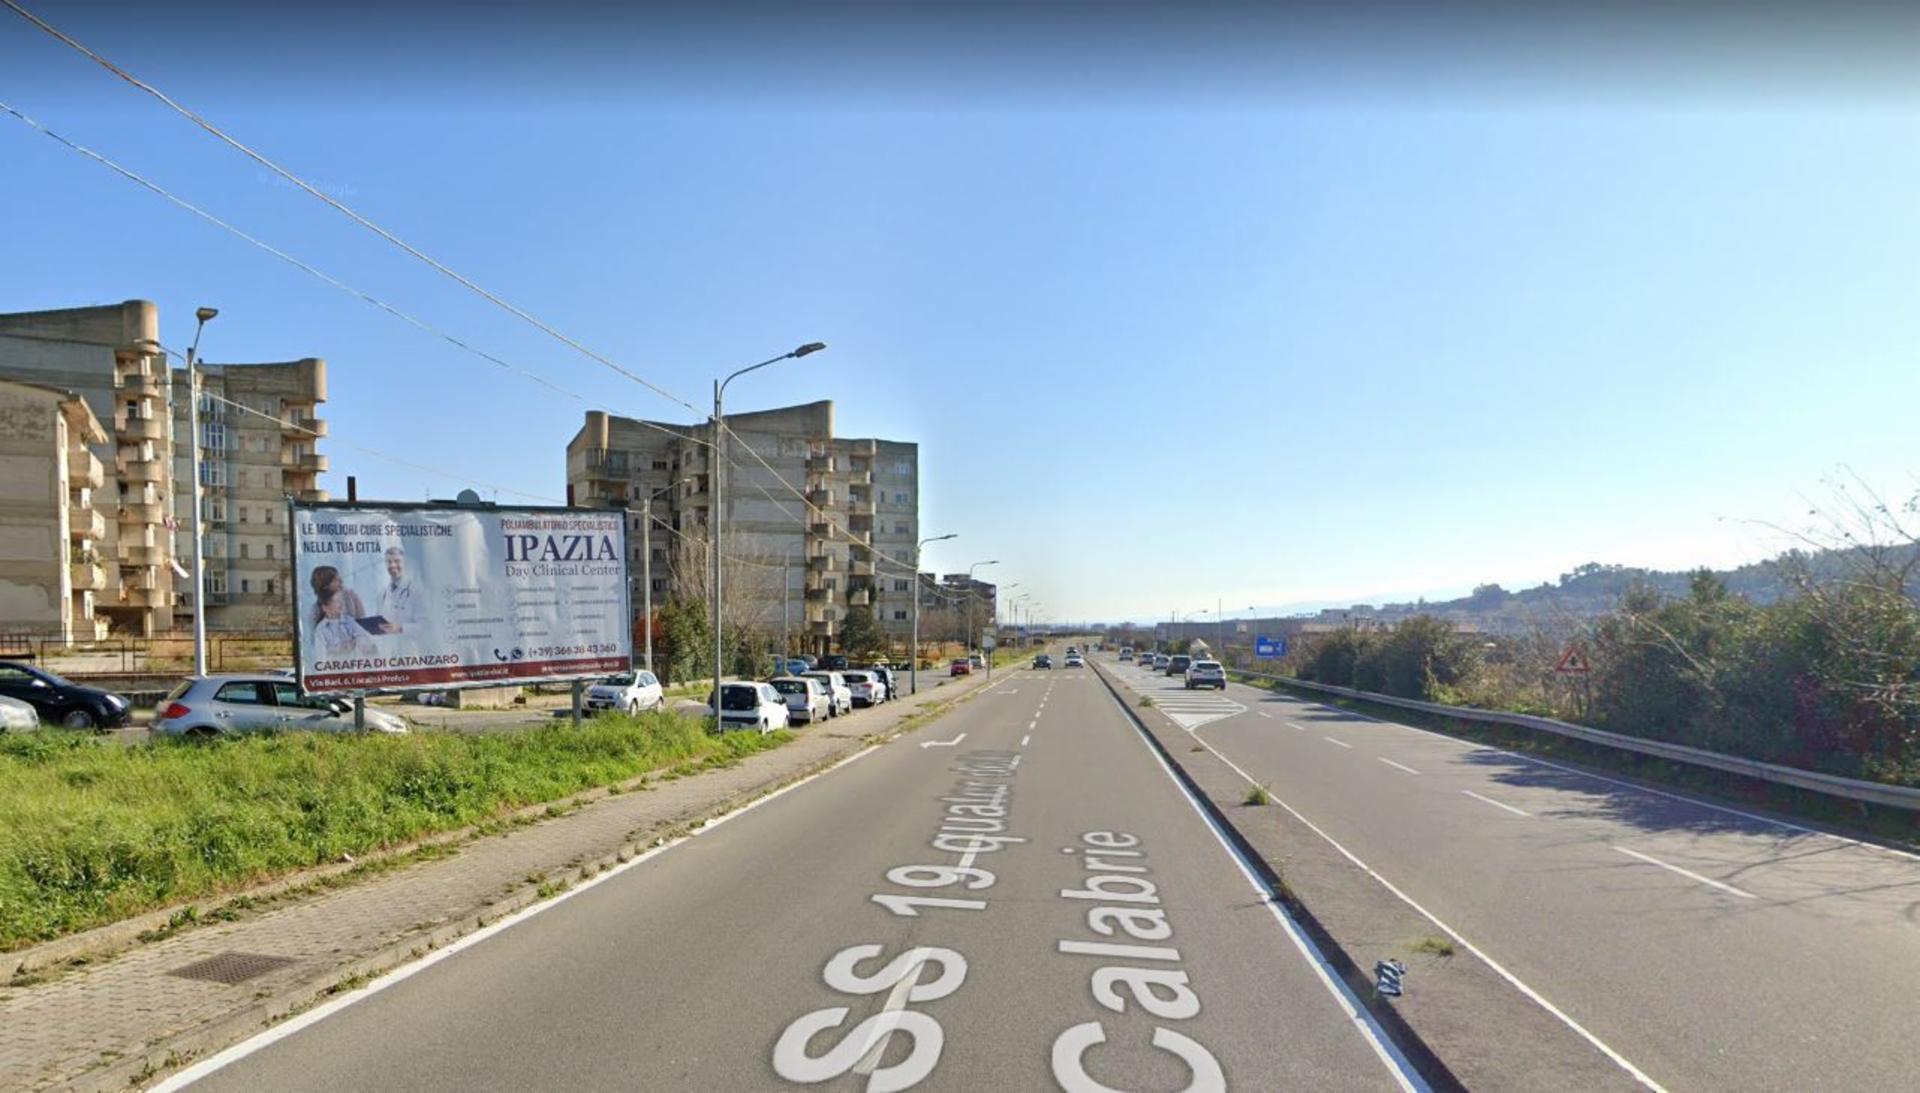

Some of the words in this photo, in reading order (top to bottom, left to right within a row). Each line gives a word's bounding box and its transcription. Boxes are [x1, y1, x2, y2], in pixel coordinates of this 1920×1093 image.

[302, 523, 315, 536] LE
[317, 523, 357, 536] MIGLIORI
[359, 524, 383, 537] CURE
[385, 524, 453, 537] SPECIALISTICHE
[302, 540, 336, 553] NELLA
[336, 541, 354, 553] TUA
[356, 539, 381, 553] CITTÀ
[504, 534, 618, 562] IPAZIA
[505, 565, 529, 580] Day
[532, 564, 578, 577] Clinical
[582, 564, 621, 576] Center
[314, 659, 372, 672] CARAFFA
[374, 658, 387, 668] DI
[388, 654, 459, 668] CATANZARO
